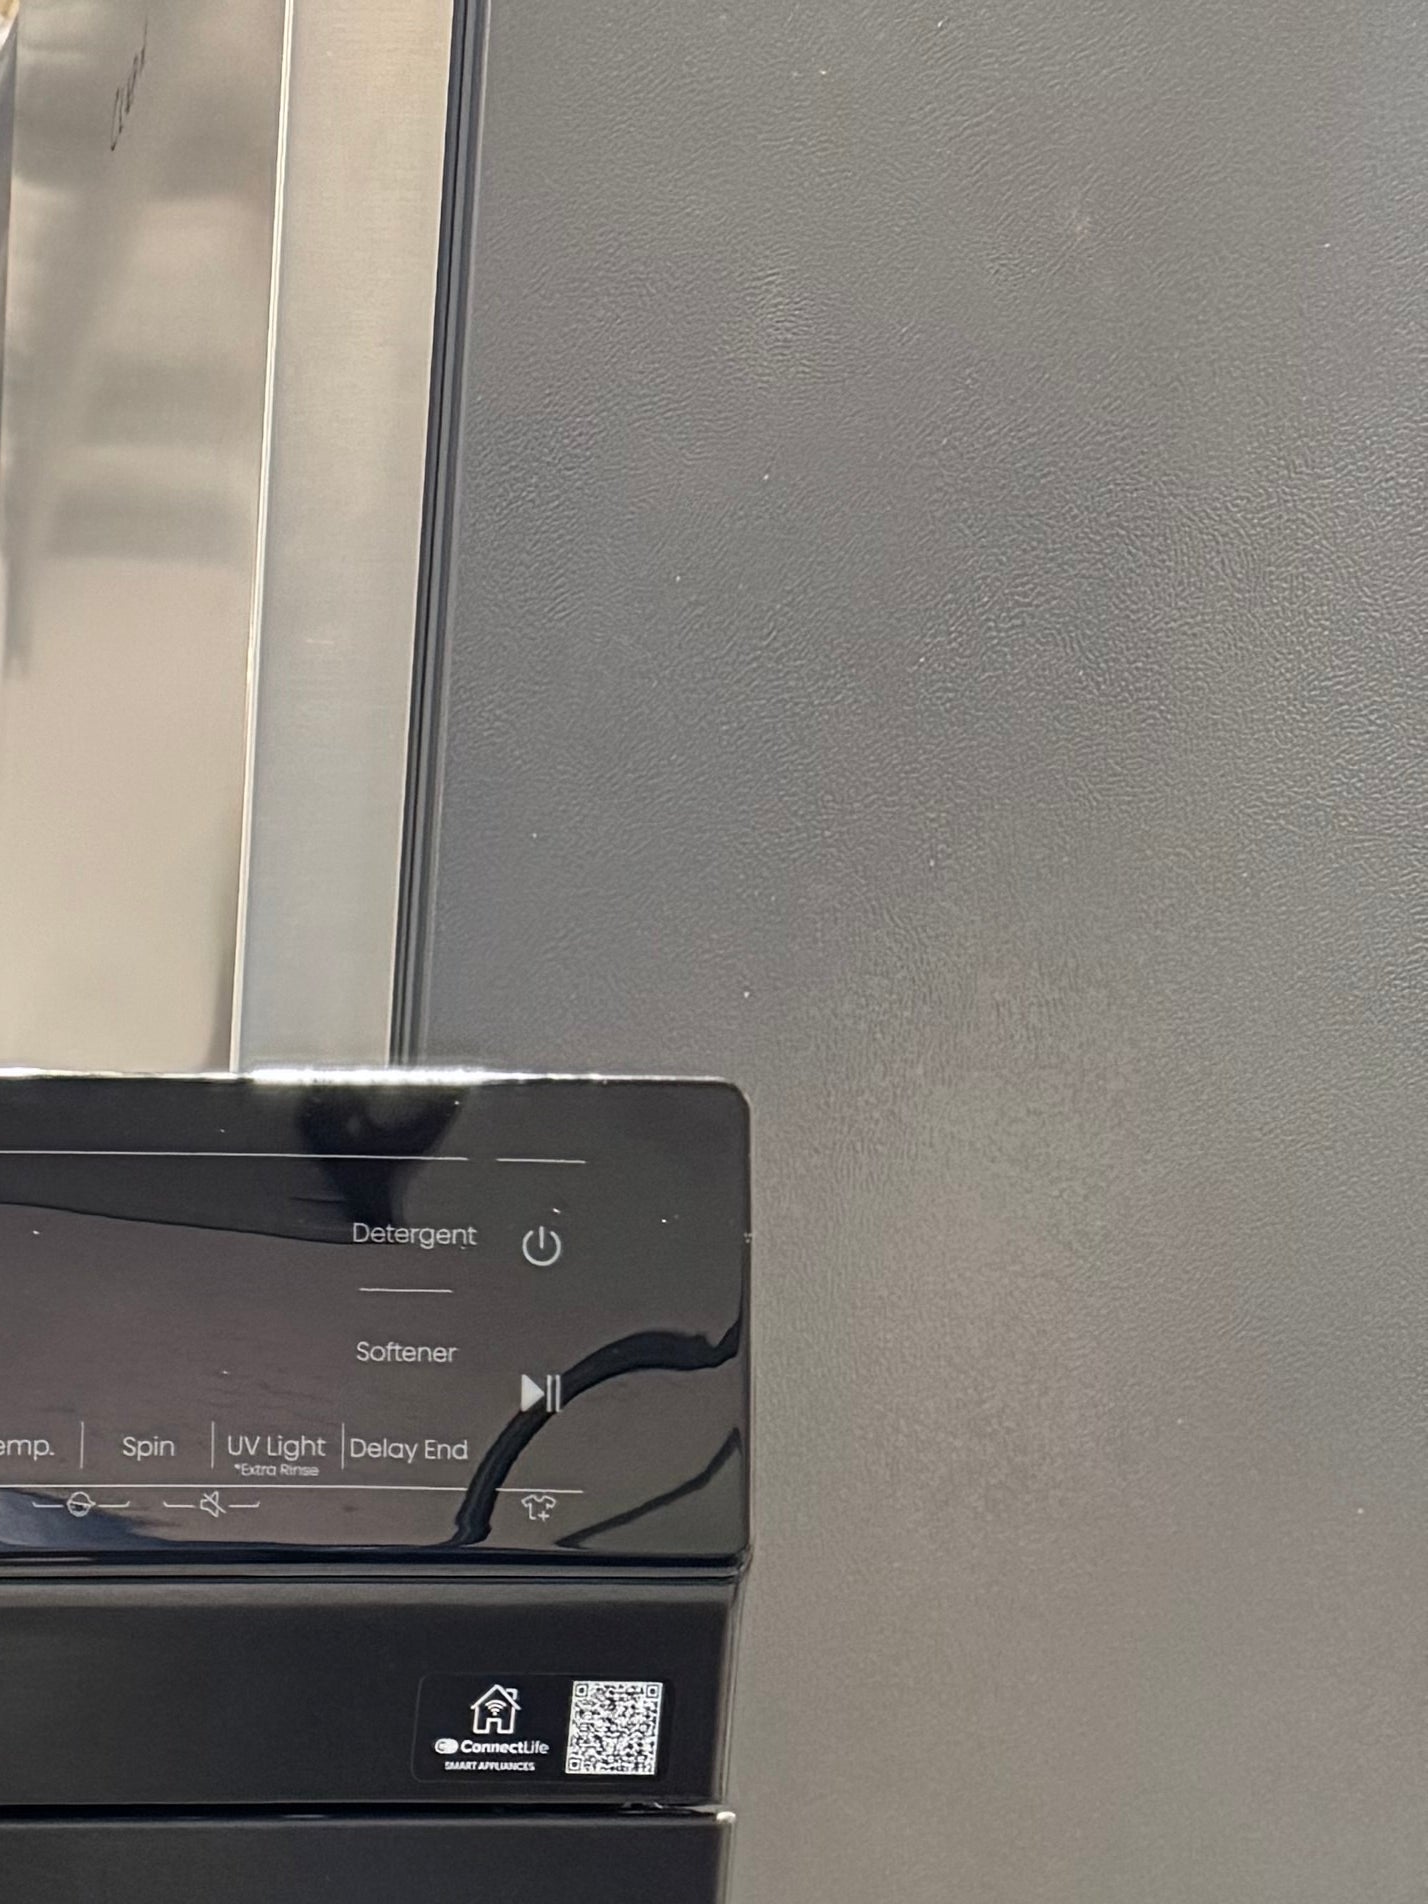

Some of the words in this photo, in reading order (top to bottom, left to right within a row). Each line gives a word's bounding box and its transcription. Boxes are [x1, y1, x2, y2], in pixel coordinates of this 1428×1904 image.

[352, 1222, 478, 1250] Detergent
[355, 1341, 458, 1363] Softener
[122, 1436, 176, 1462] Spin
[227, 1434, 261, 1456] UV
[267, 1435, 327, 1461] Light
[350, 1437, 418, 1464] Delay
[424, 1439, 469, 1461] End
[279, 1464, 320, 1477] Rinse
[444, 1761, 477, 1771] SMART
